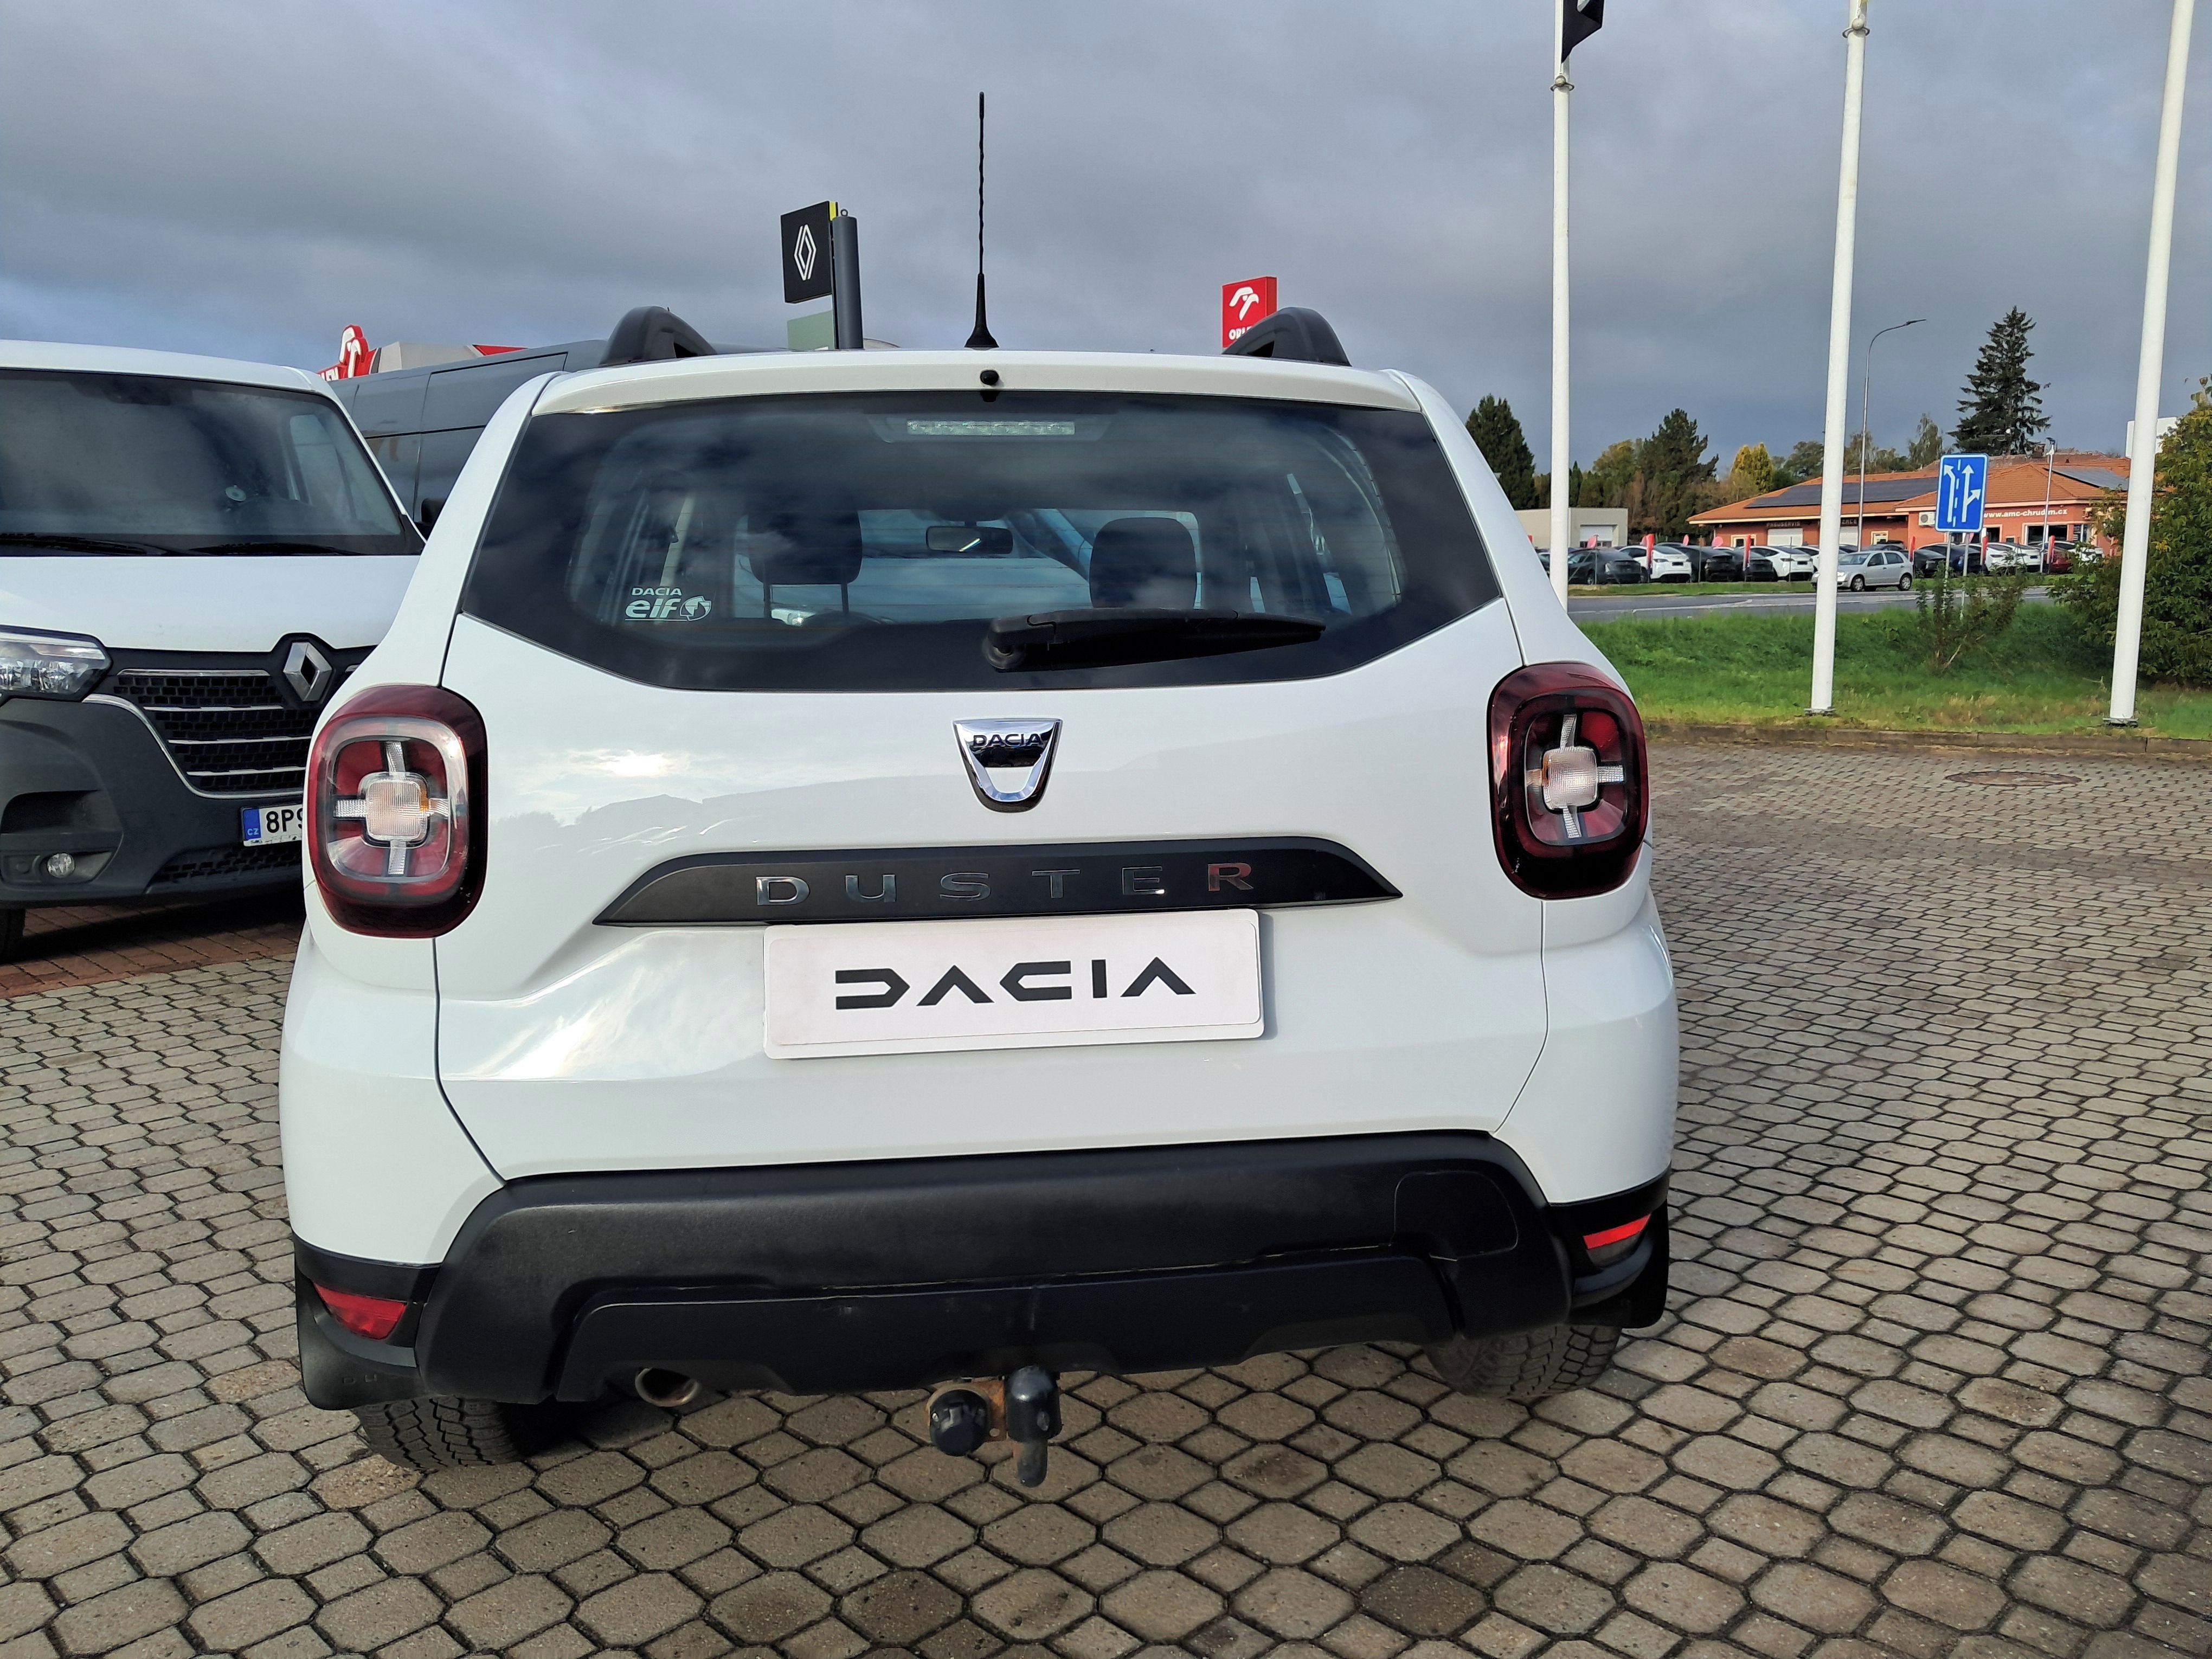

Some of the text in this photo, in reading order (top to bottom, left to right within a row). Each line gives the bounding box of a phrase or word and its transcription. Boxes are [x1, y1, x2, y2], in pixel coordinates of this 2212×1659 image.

[1984, 509, 2068, 518] www.amc-chrudm.cz
[631, 587, 683, 596] DACIA
[625, 598, 681, 618] elf
[973, 733, 1042, 748] DACIA
[756, 862, 1254, 906] DUSTER
[835, 956, 1197, 1010] DACIA
